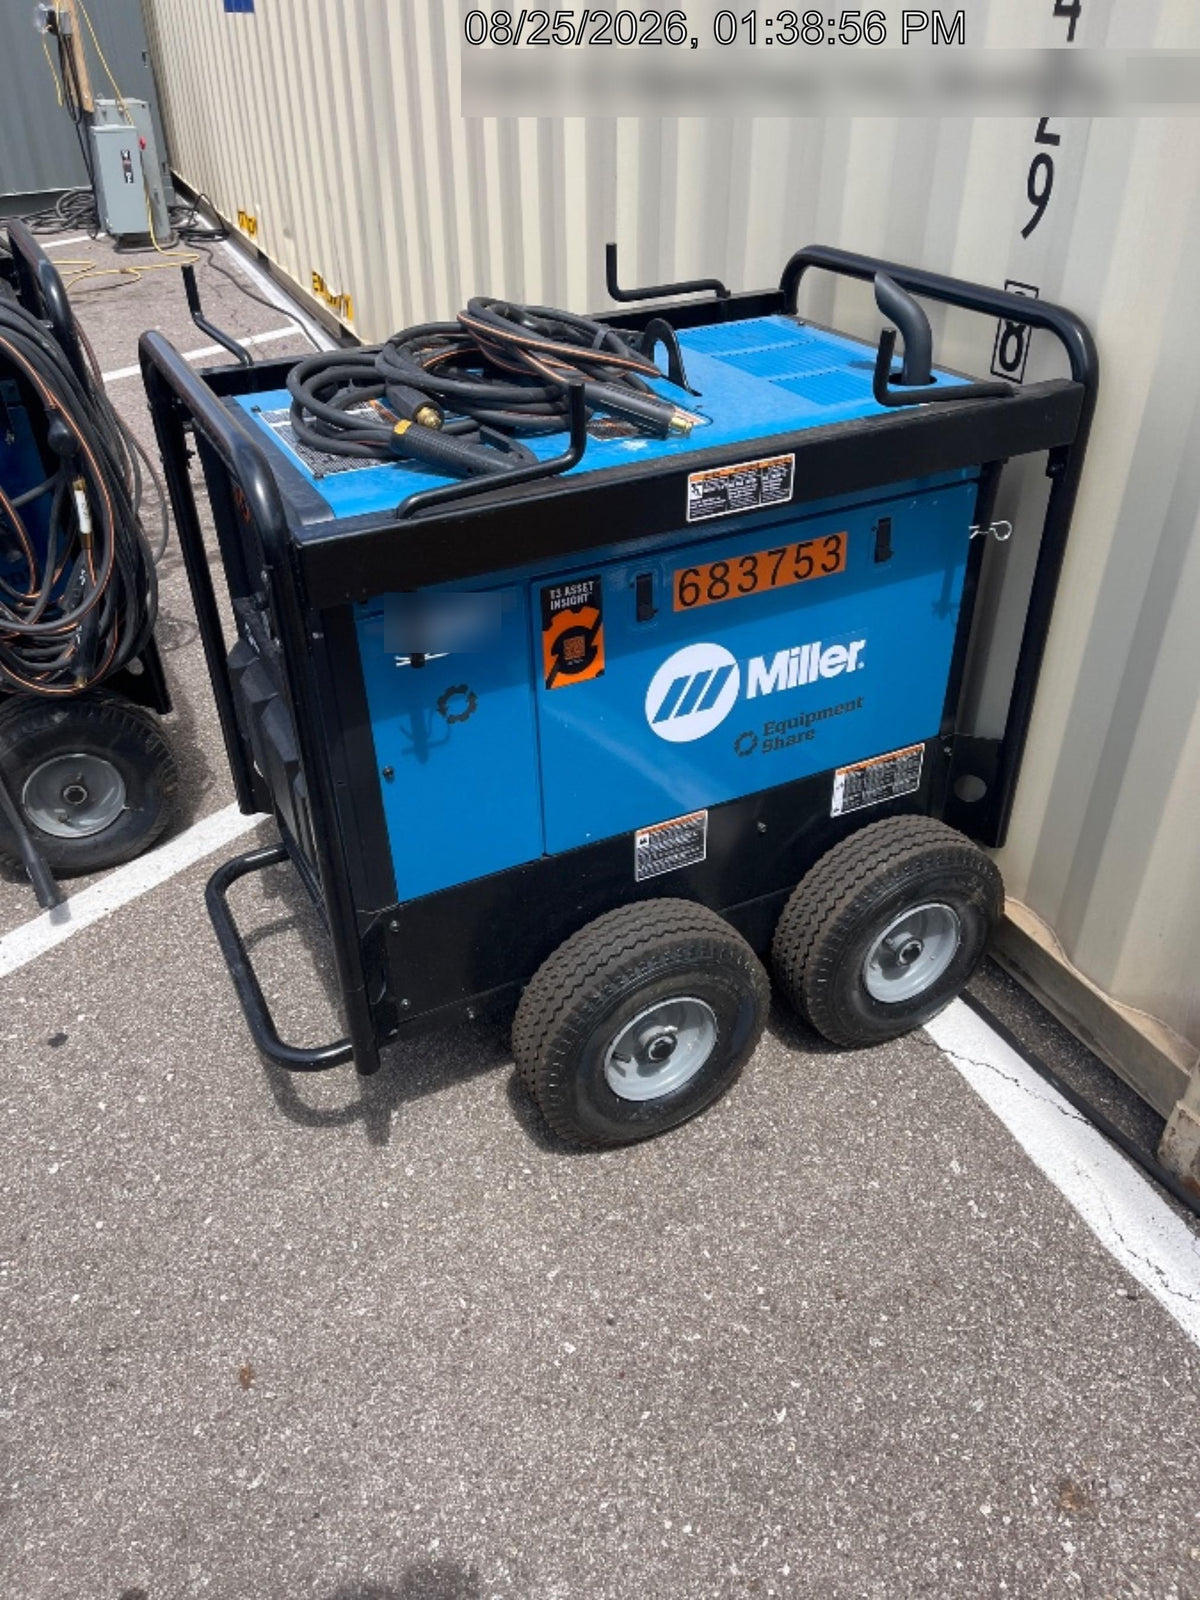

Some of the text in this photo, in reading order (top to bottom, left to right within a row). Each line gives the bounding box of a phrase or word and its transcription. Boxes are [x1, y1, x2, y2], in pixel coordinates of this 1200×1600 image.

[678, 534, 842, 606] 683753
[550, 593, 588, 610] INSIGHT
[564, 581, 594, 597] ASSET
[746, 639, 867, 700] Miller
[762, 696, 864, 737] Equipment
[761, 728, 816, 754] Share
